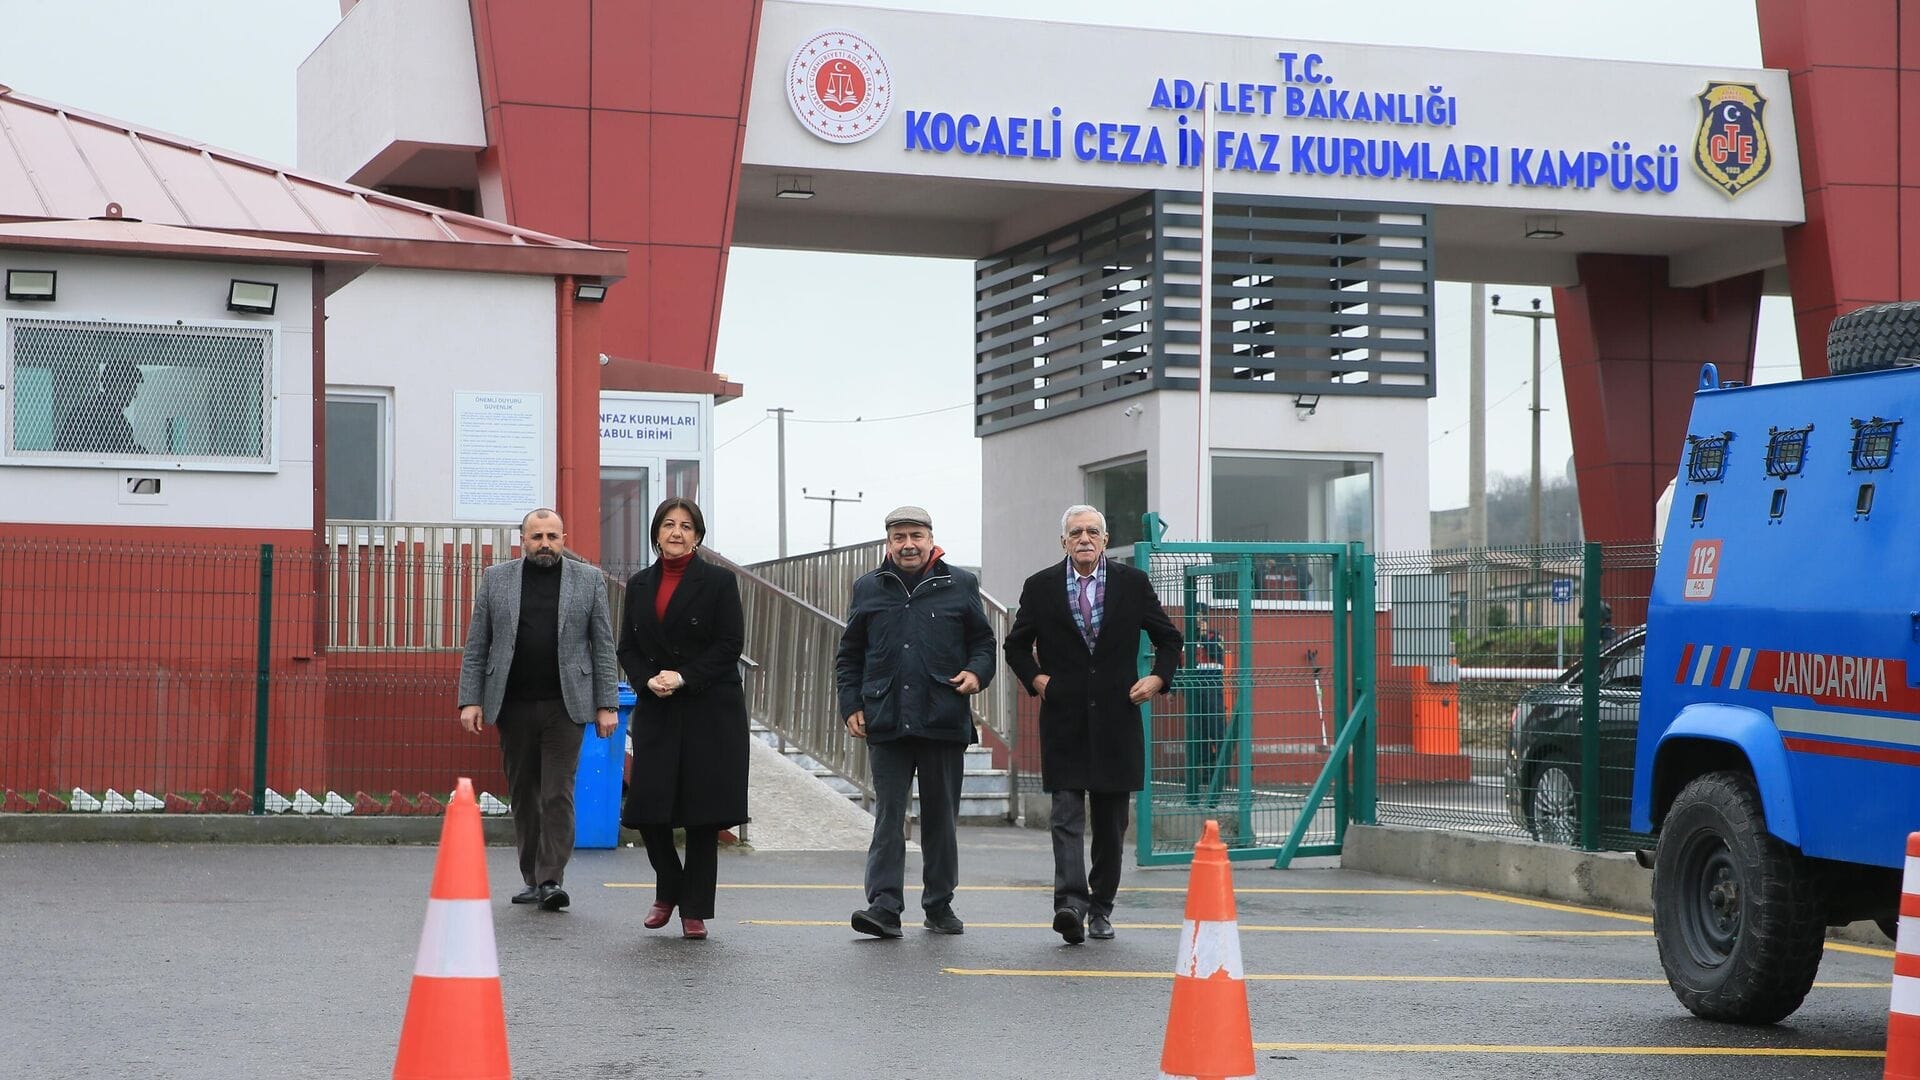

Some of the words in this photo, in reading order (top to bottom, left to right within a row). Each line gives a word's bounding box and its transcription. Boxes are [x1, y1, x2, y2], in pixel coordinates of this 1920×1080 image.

[1278, 53, 1333, 84] T.C.
[1285, 86, 1457, 126] BAKANLIĞI
[905, 107, 1062, 159] KOCAELİ
[1073, 122, 1168, 164] CEZA
[1291, 135, 1500, 184] KURUMLARI
[1510, 142, 1679, 193] KAMPÜSÜ
[1711, 124, 1752, 164] CTE
[599, 413, 627, 424] NFAZ
[629, 414, 696, 426] KURUMLARI
[636, 427, 673, 440] BİRİMİ
[1692, 546, 1716, 575] 112
[1773, 651, 1888, 703] JANDARMA
